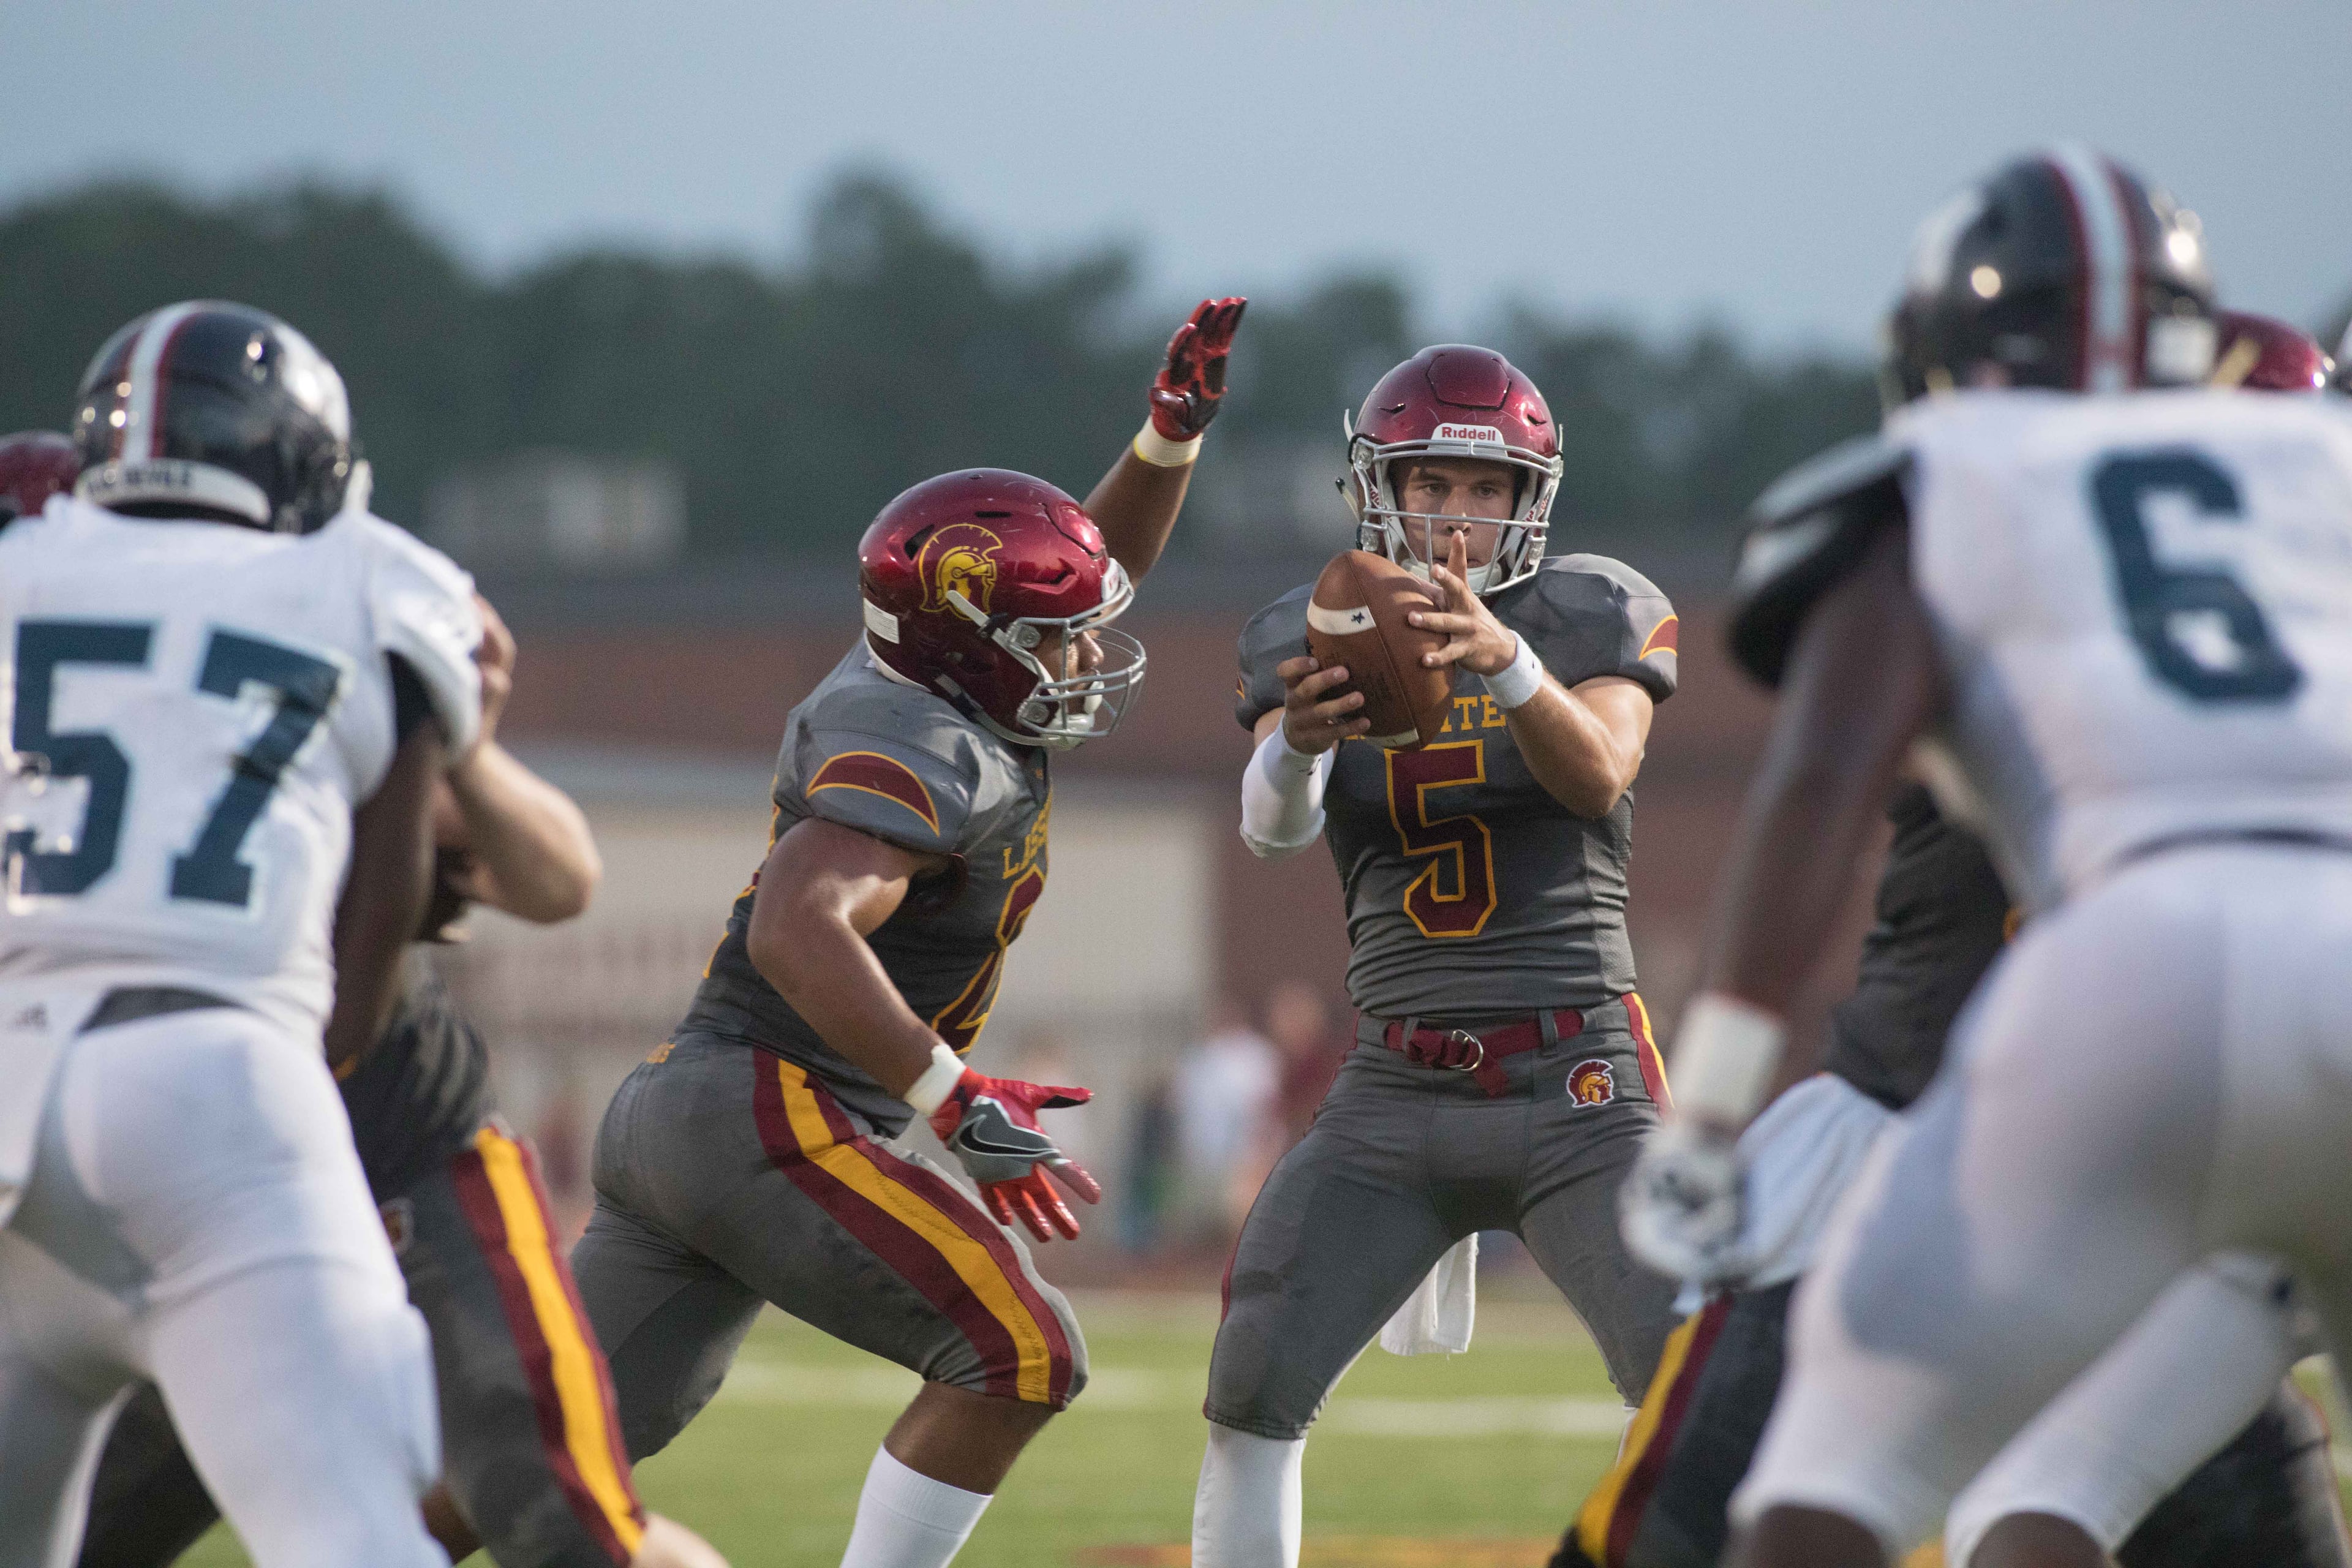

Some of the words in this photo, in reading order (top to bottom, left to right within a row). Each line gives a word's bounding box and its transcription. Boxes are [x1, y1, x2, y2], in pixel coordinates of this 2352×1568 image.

[1442, 426, 1496, 441] Riddell
[2086, 447, 2305, 707] 6
[5, 620, 342, 907] 57
[1383, 739, 1498, 938] 5
